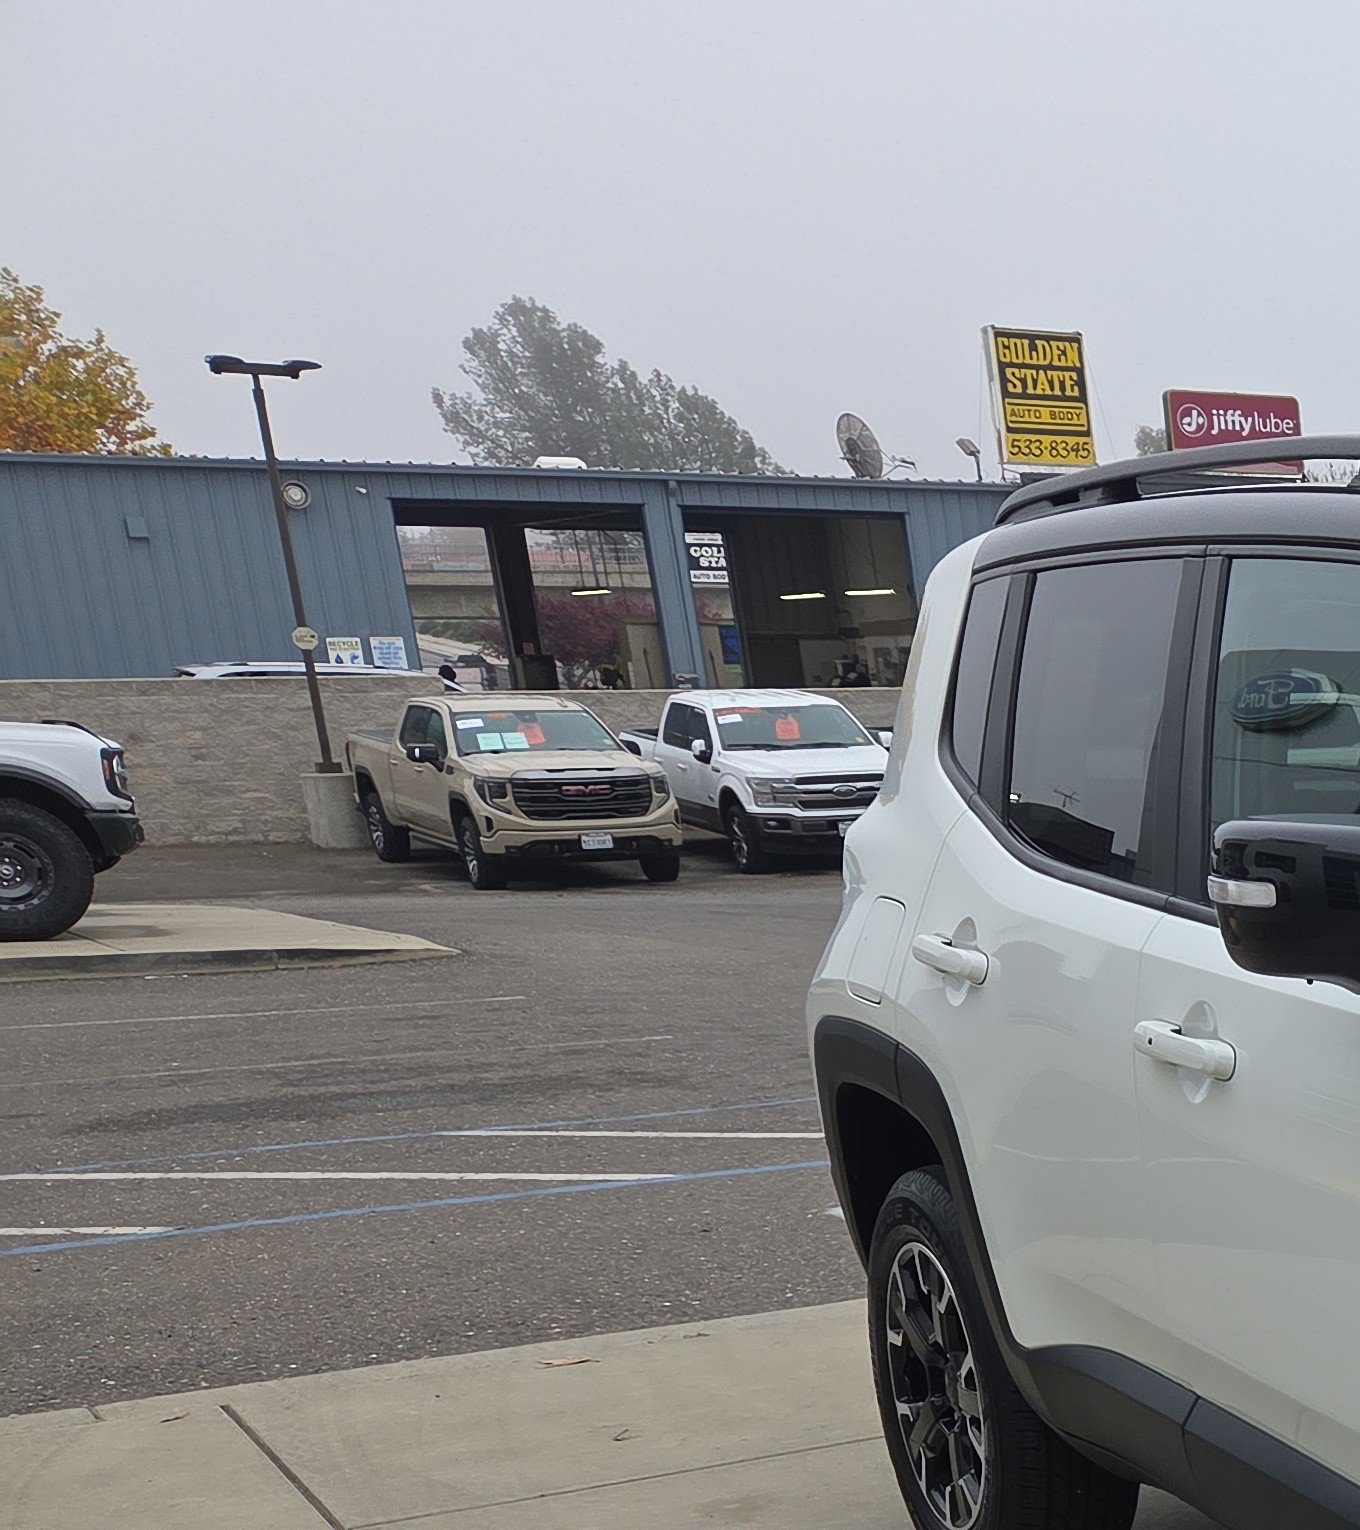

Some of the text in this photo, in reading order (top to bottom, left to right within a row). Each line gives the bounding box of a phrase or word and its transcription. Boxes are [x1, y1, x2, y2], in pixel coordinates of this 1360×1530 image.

[997, 337, 1081, 367] GOLDEN
[1005, 367, 1080, 397] STATE
[1009, 408, 1081, 422] AUTO BODY
[690, 546, 725, 557] GOL
